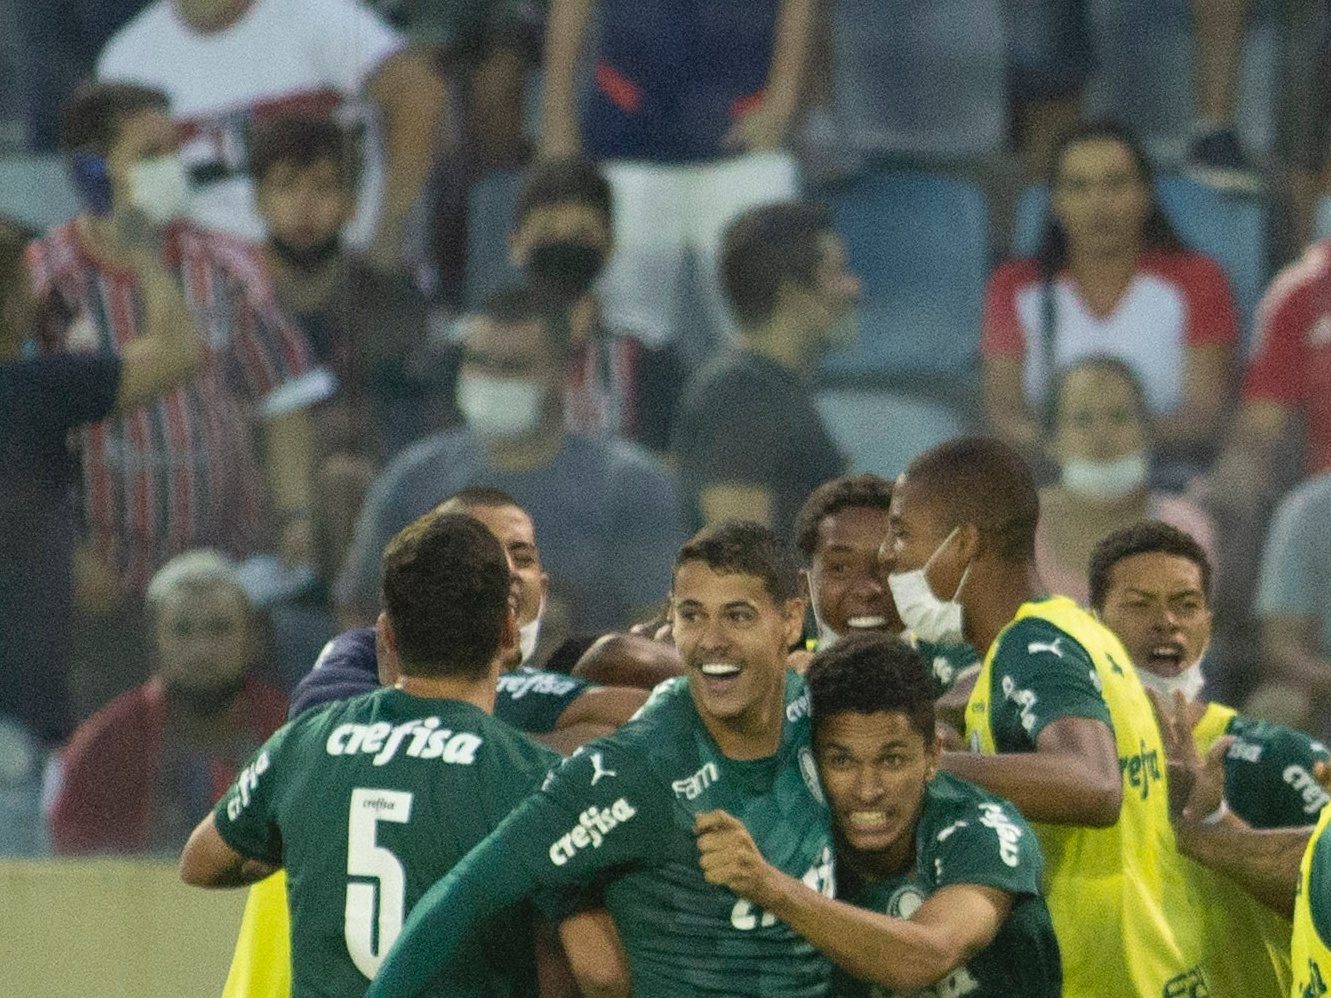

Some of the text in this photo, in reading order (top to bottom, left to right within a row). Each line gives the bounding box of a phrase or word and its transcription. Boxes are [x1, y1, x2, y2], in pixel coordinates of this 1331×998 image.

[326, 716, 483, 767] crefisa
[549, 798, 636, 867] crefisa
[344, 787, 413, 982] 5
